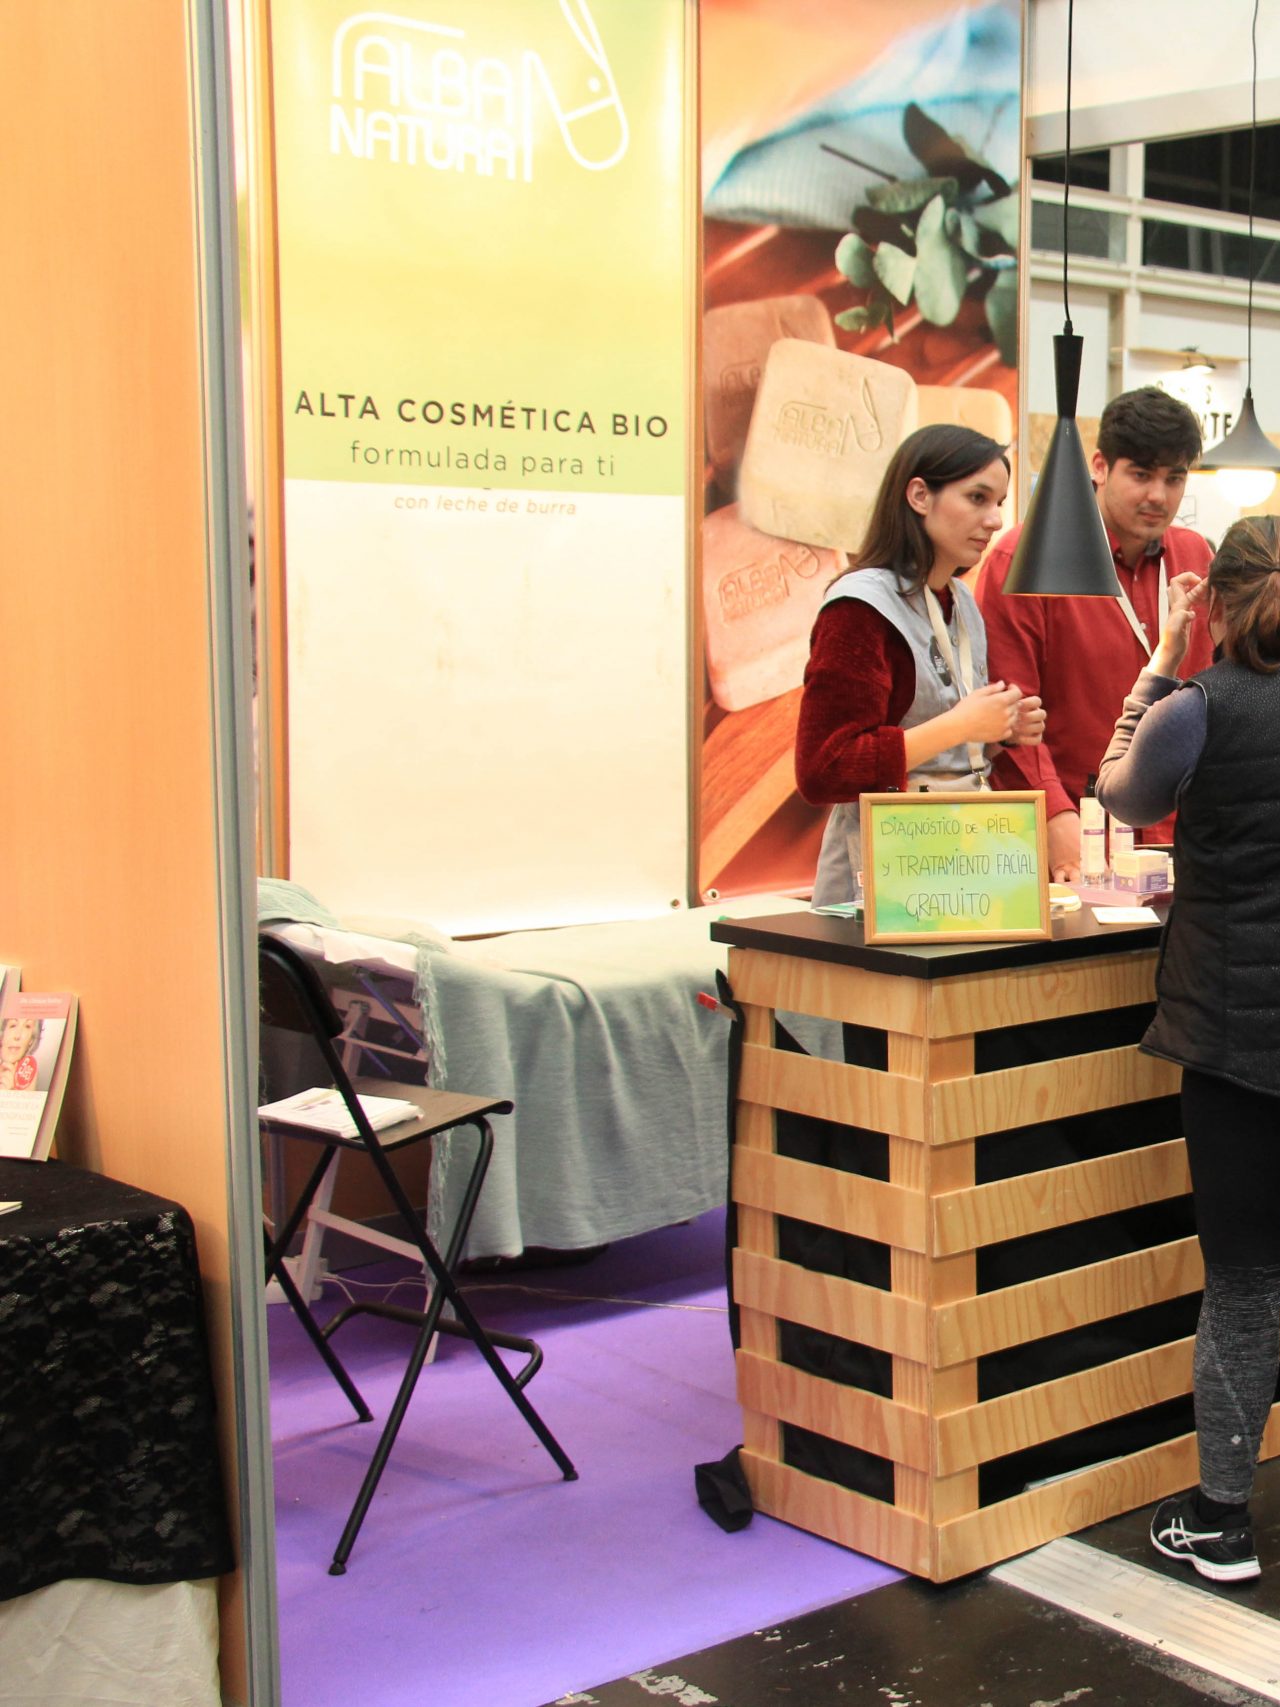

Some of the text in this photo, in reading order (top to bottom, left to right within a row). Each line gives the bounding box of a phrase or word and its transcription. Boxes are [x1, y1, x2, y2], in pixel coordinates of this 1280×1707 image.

[295, 390, 669, 438] ALTA COSMÉTICA BIO
[350, 440, 615, 476] formulada para ti
[394, 494, 577, 515] con leche de burra
